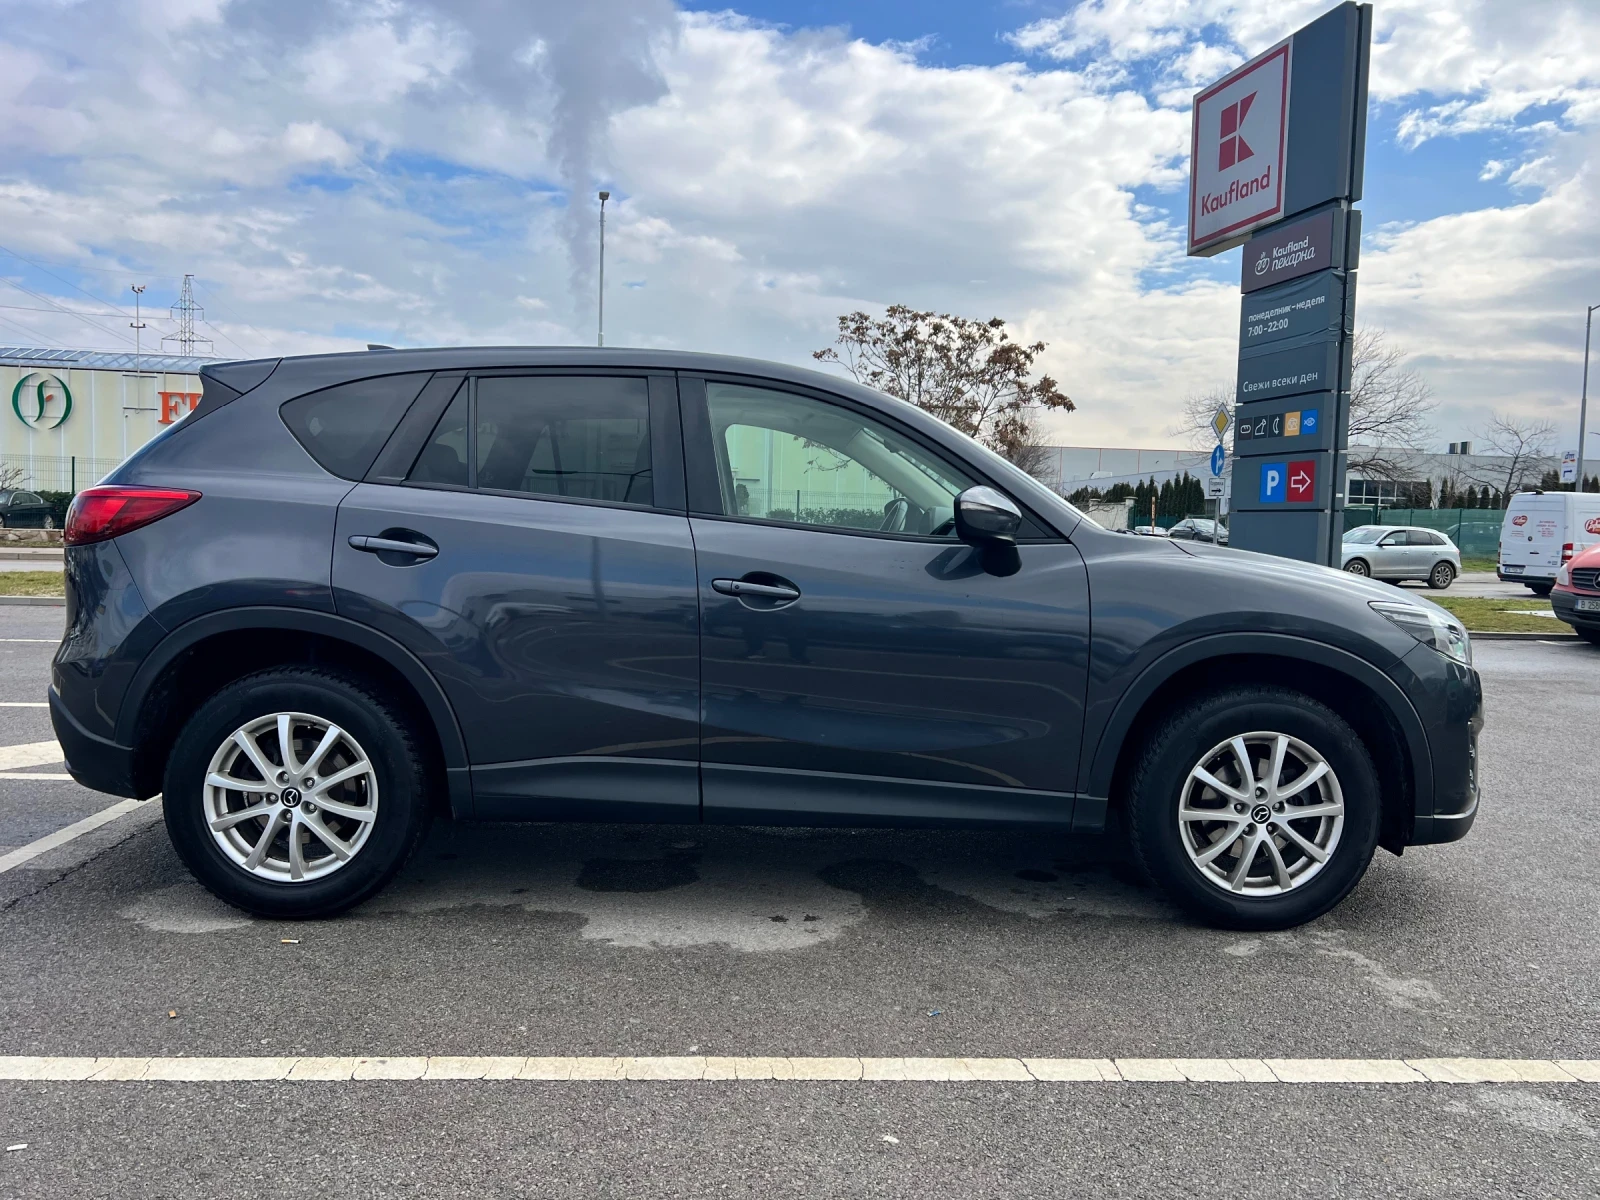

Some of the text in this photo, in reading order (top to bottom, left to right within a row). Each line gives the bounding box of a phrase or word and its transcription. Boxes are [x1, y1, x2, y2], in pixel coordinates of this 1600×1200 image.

[1201, 165, 1271, 216] Kaufland
[1271, 246, 1316, 272] пекарна
[1272, 236, 1309, 258] Kaufland
[1242, 371, 1318, 393] Свежи всеки ден
[1266, 470, 1280, 496] P
